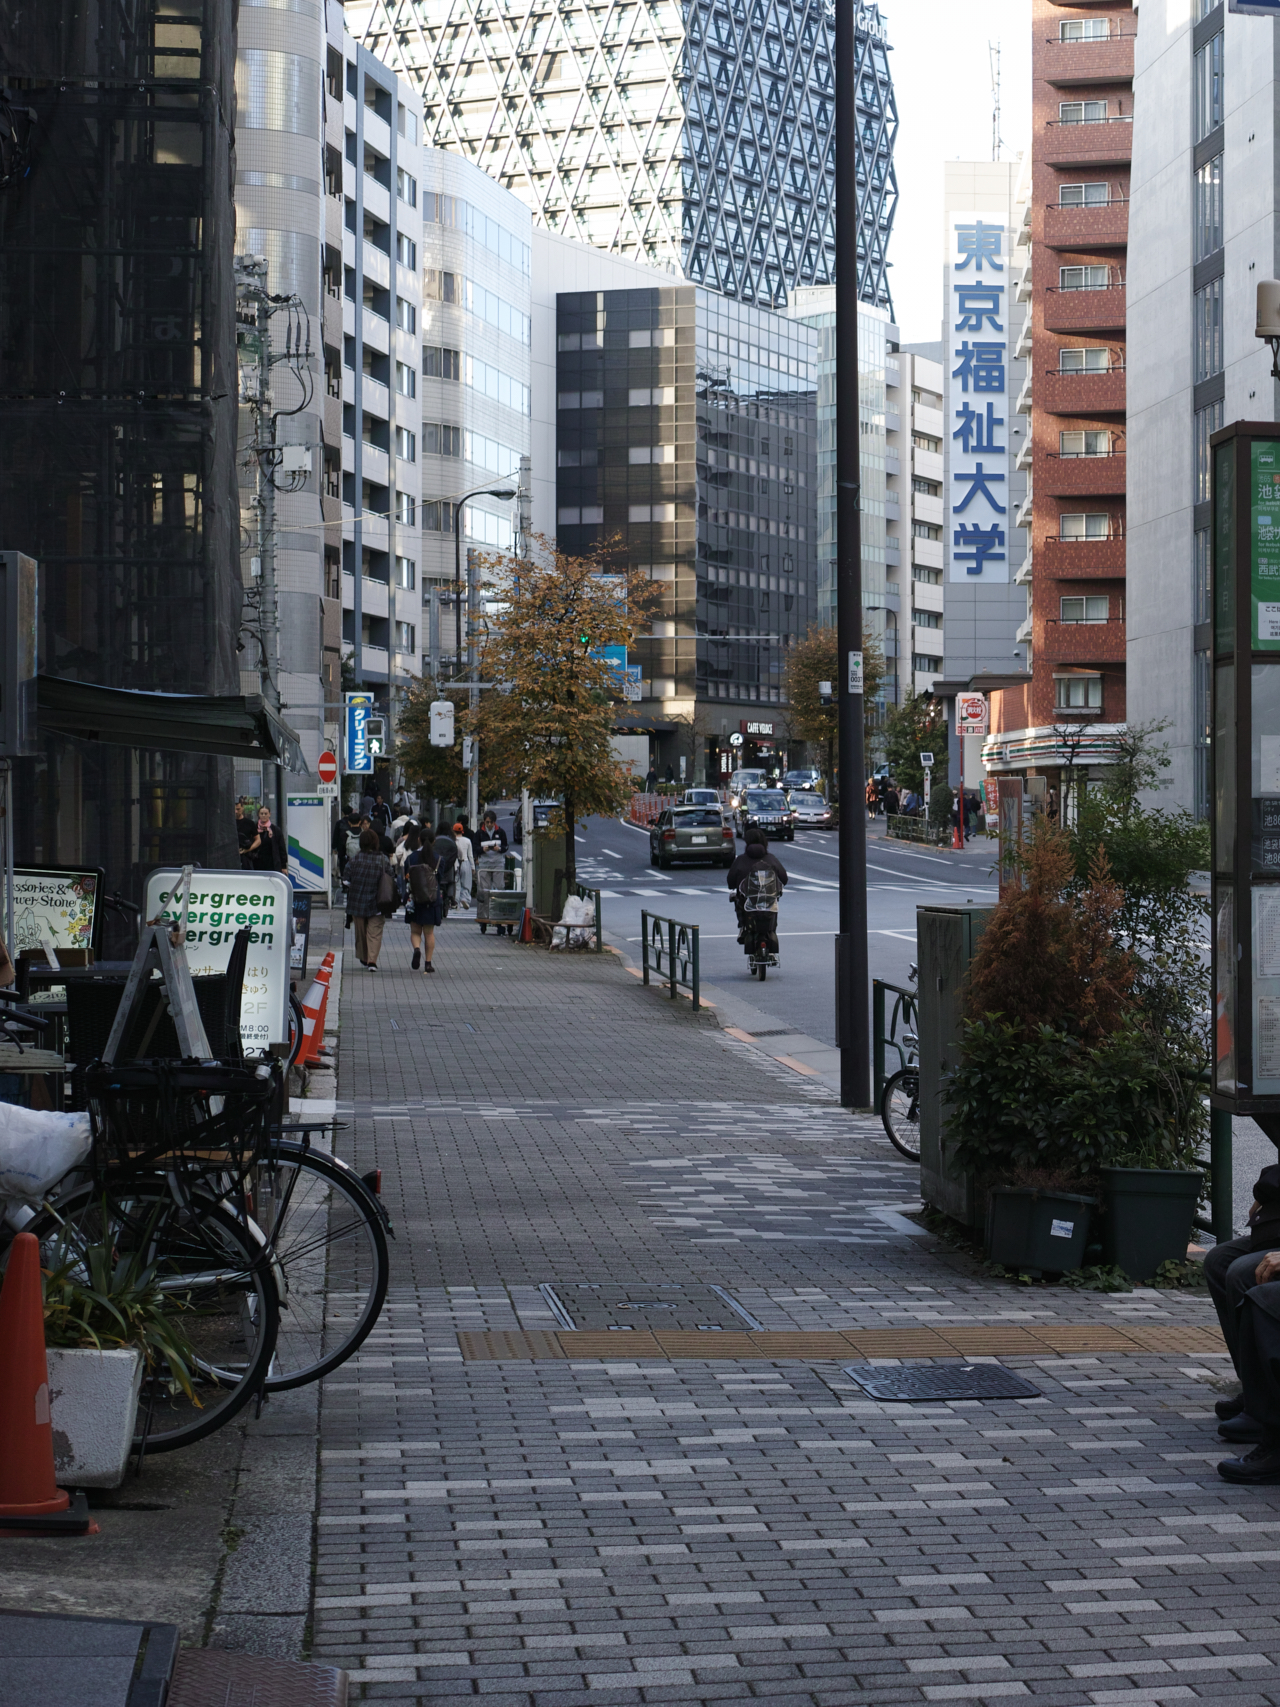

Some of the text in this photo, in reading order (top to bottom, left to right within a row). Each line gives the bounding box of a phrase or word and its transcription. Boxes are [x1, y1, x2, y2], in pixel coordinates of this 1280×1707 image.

[856, 12, 888, 43] Group
[952, 220, 1006, 575] 東京福祉大学
[354, 709, 367, 769] クリーニング
[987, 784, 997, 809] おせち
[56, 884, 69, 895] &
[159, 892, 275, 908] evergreen
[186, 930, 273, 946] ergren
[248, 966, 268, 978] はり
[244, 1002, 268, 1014] 2F
